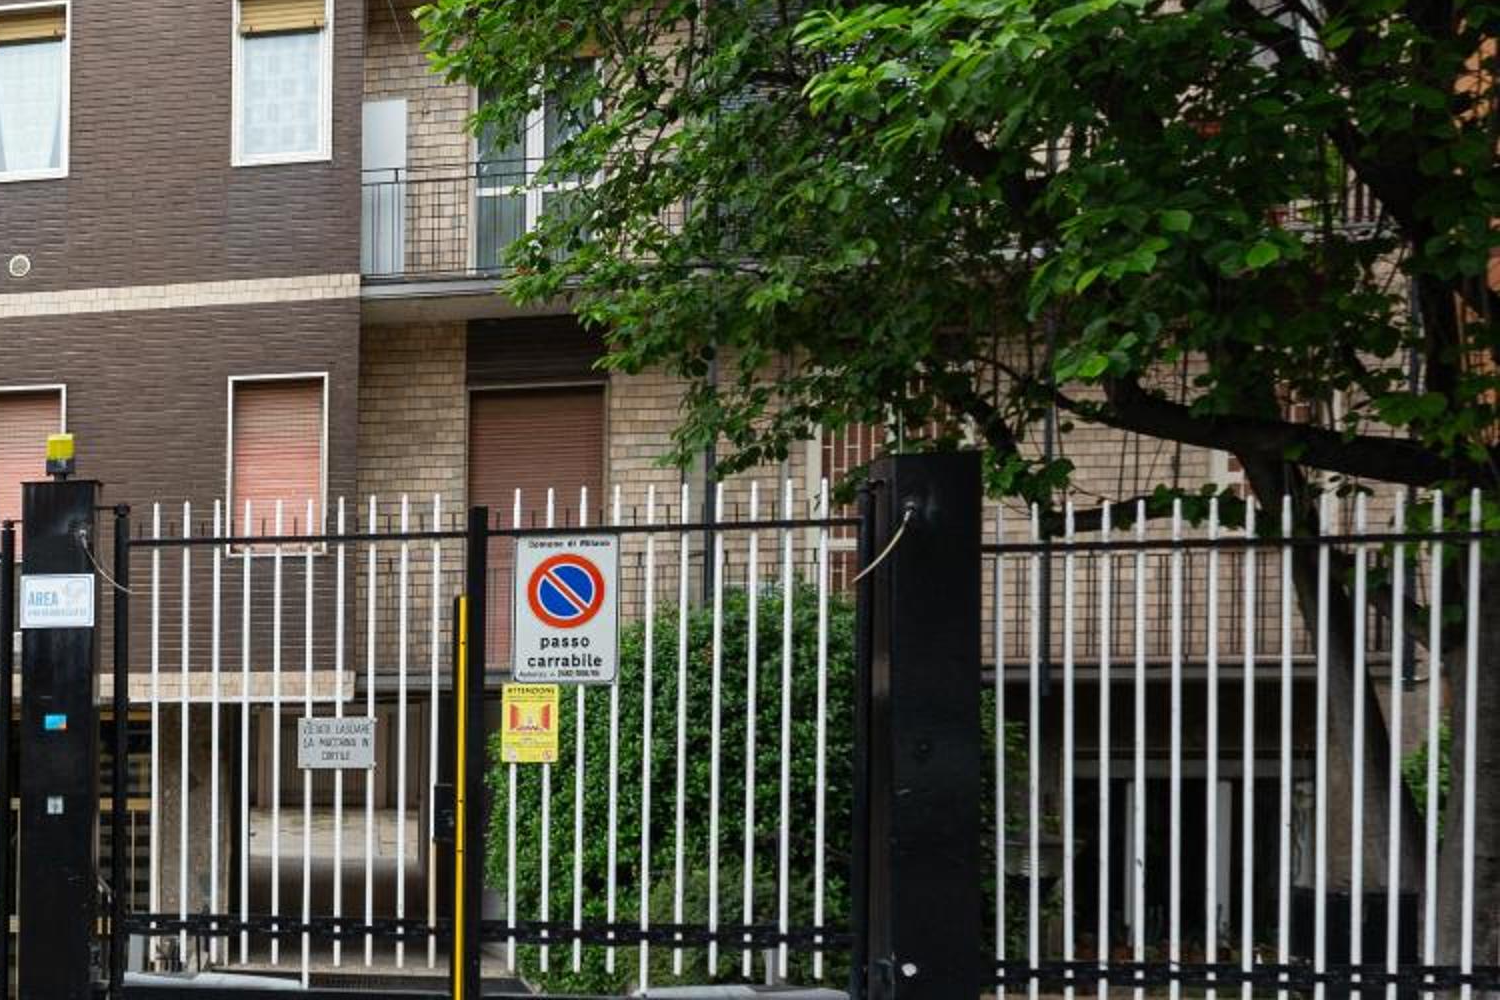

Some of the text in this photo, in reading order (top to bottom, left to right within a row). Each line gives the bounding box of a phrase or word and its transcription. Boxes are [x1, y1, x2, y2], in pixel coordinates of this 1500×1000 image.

[567, 539, 578, 548] di
[579, 539, 611, 548] Milano
[29, 591, 58, 606] AREA
[540, 637, 590, 650] passo
[527, 653, 603, 668] carrabile
